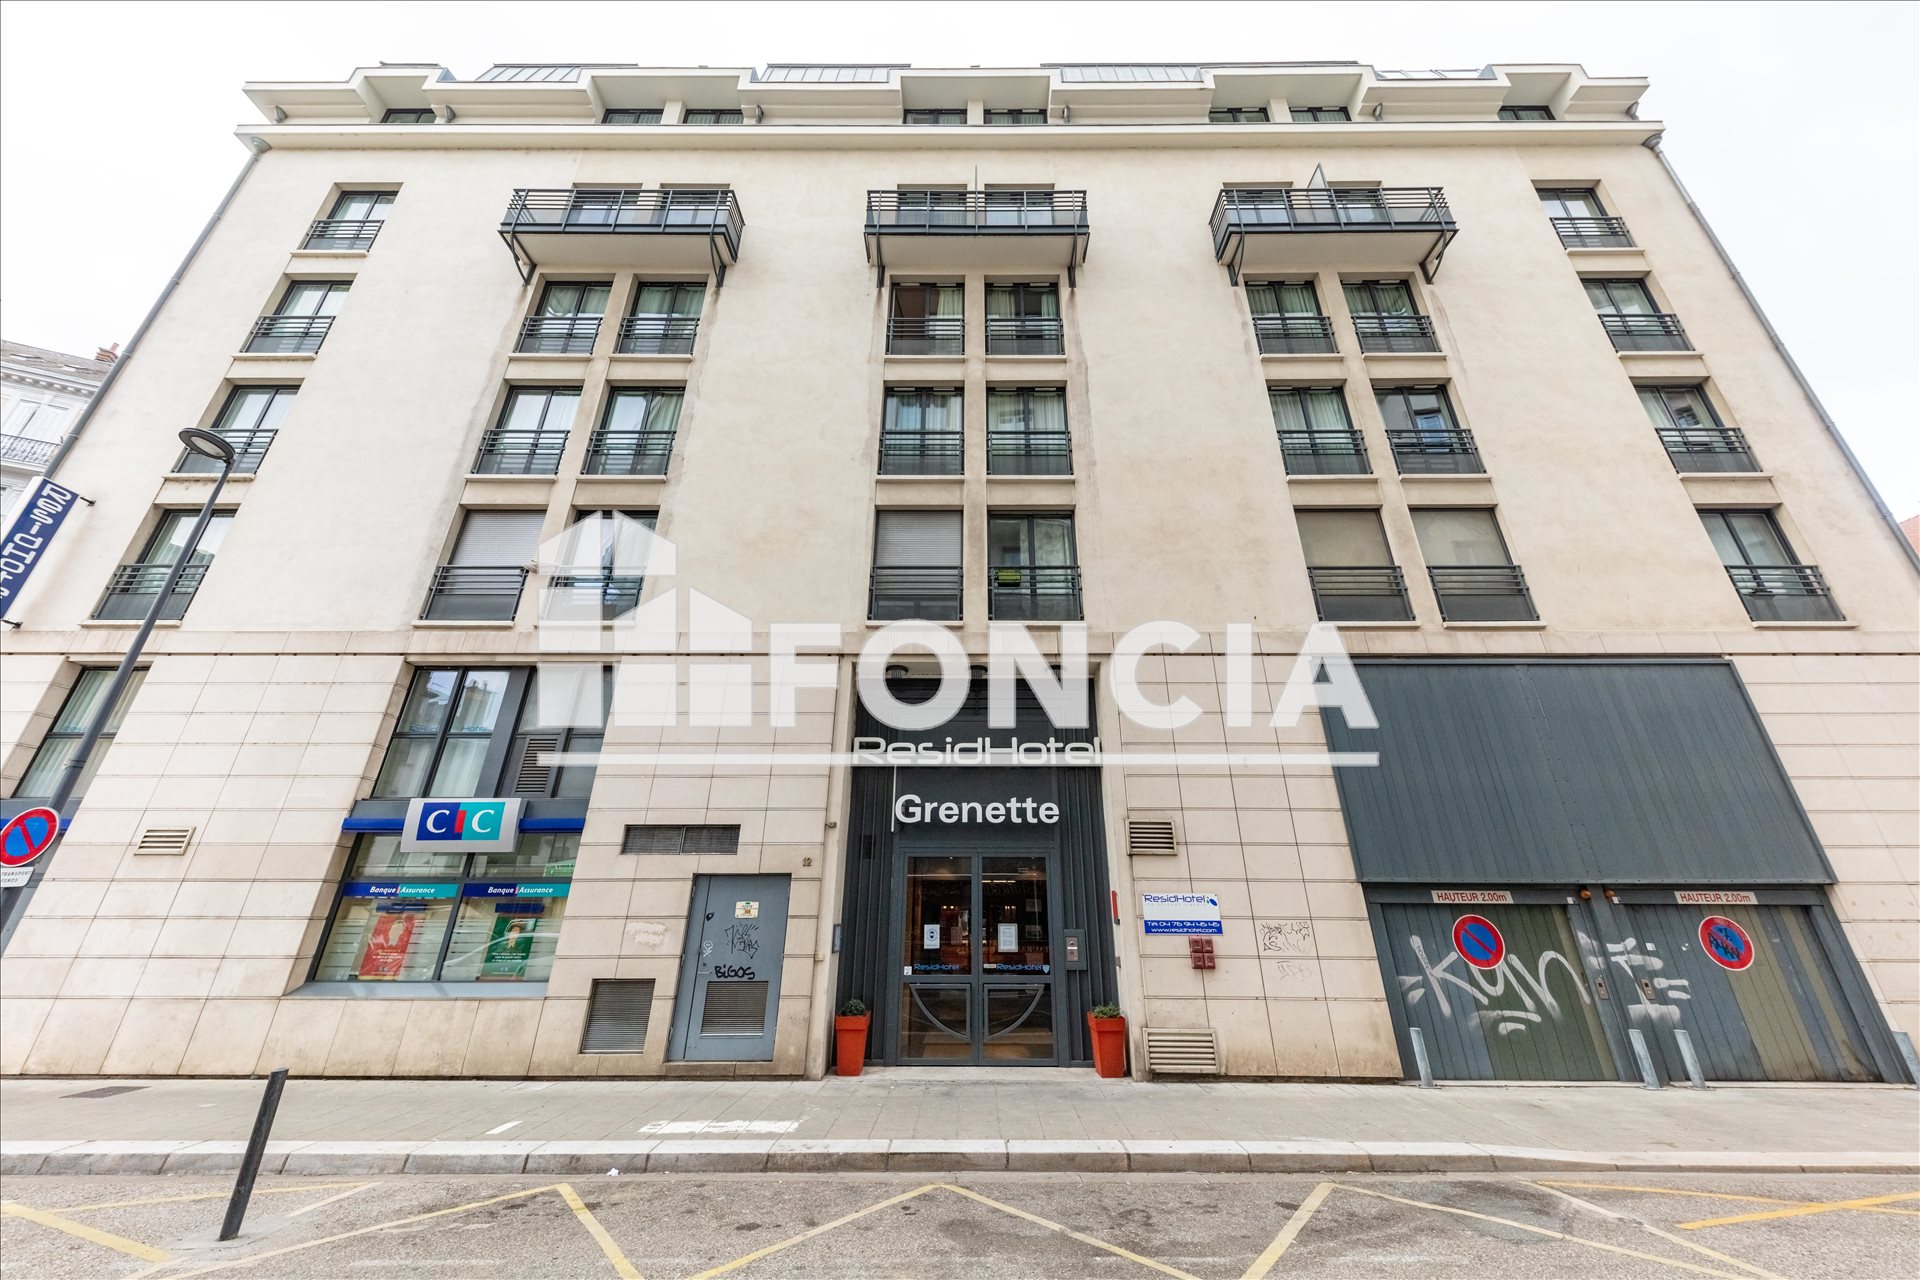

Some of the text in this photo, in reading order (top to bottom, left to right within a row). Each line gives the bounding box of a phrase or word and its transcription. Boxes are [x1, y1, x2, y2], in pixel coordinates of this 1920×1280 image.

[853, 737, 1100, 765] ResidHotel
[895, 794, 1060, 823] Grenette
[426, 809, 495, 833] CIC
[802, 857, 812, 867] 12
[369, 886, 396, 895] Banque
[487, 886, 514, 895] Banque
[1144, 894, 1205, 902] ResidHotel
[1437, 892, 1507, 902] HAUTEUR 2.00m
[1680, 893, 1751, 902] HAUTEUR 2.00m
